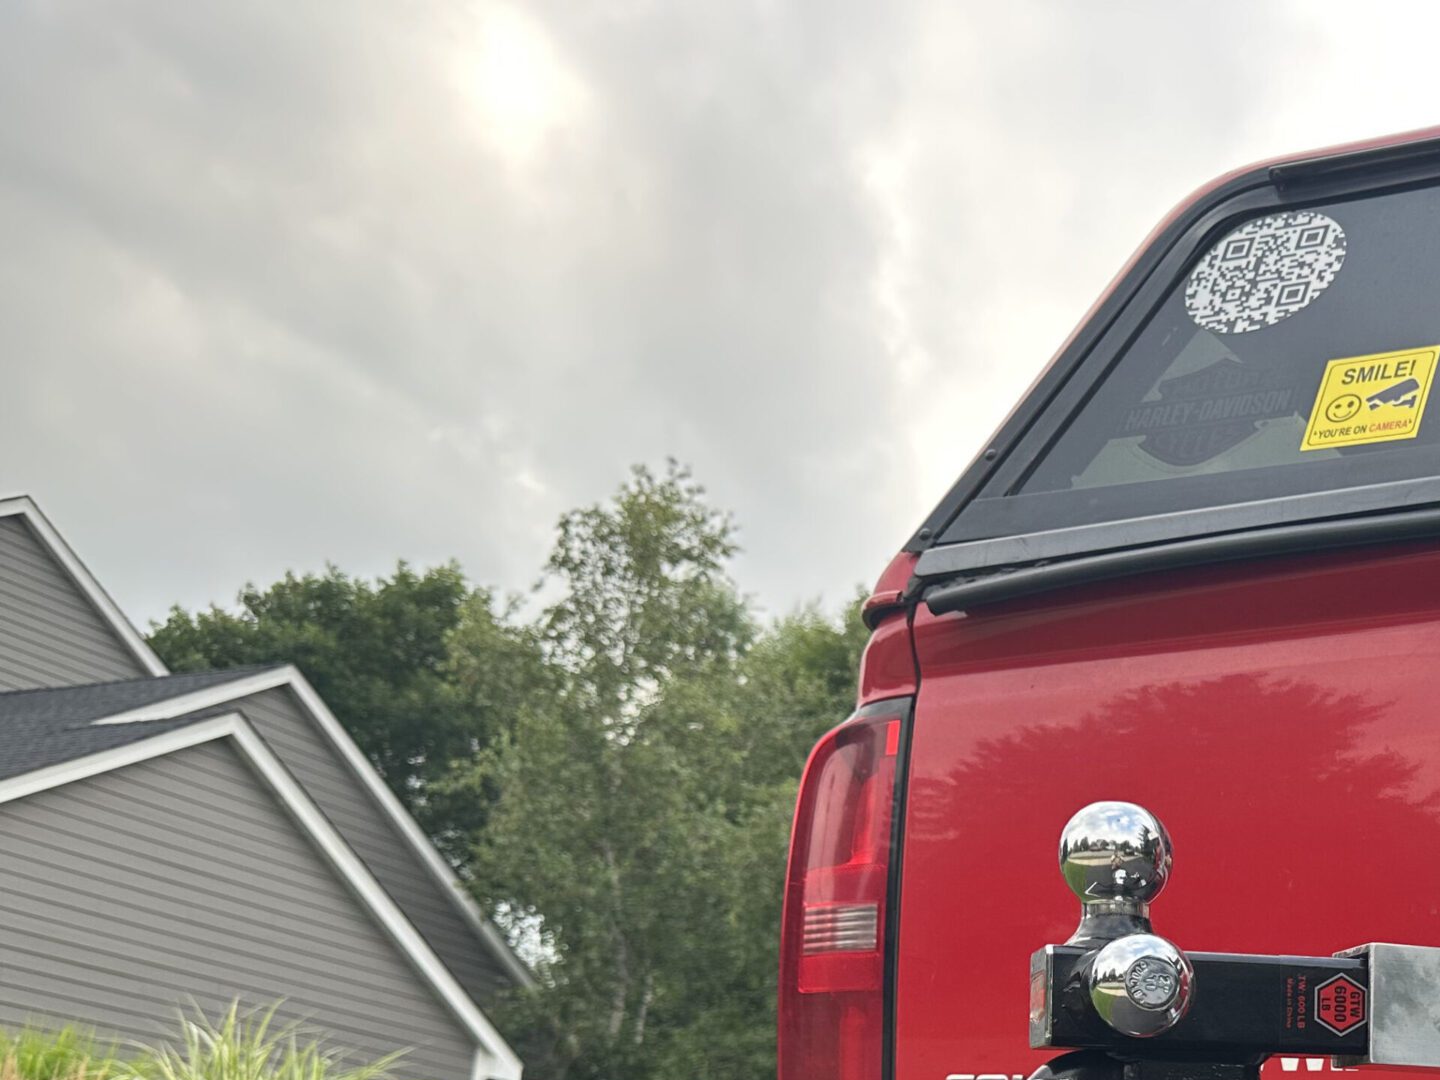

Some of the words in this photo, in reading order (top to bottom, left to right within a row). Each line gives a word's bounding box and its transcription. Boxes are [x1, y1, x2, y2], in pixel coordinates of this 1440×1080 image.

[1341, 359, 1416, 386] SMILE!
[1125, 389, 1292, 431] HARLEY-DAVIDSON
[1353, 424, 1368, 434] ON
[1321, 997, 1331, 1011] LB
[1334, 986, 1347, 1023] 6000
[1350, 992, 1361, 1018] GTW
[1296, 1015, 1306, 1029] LB
